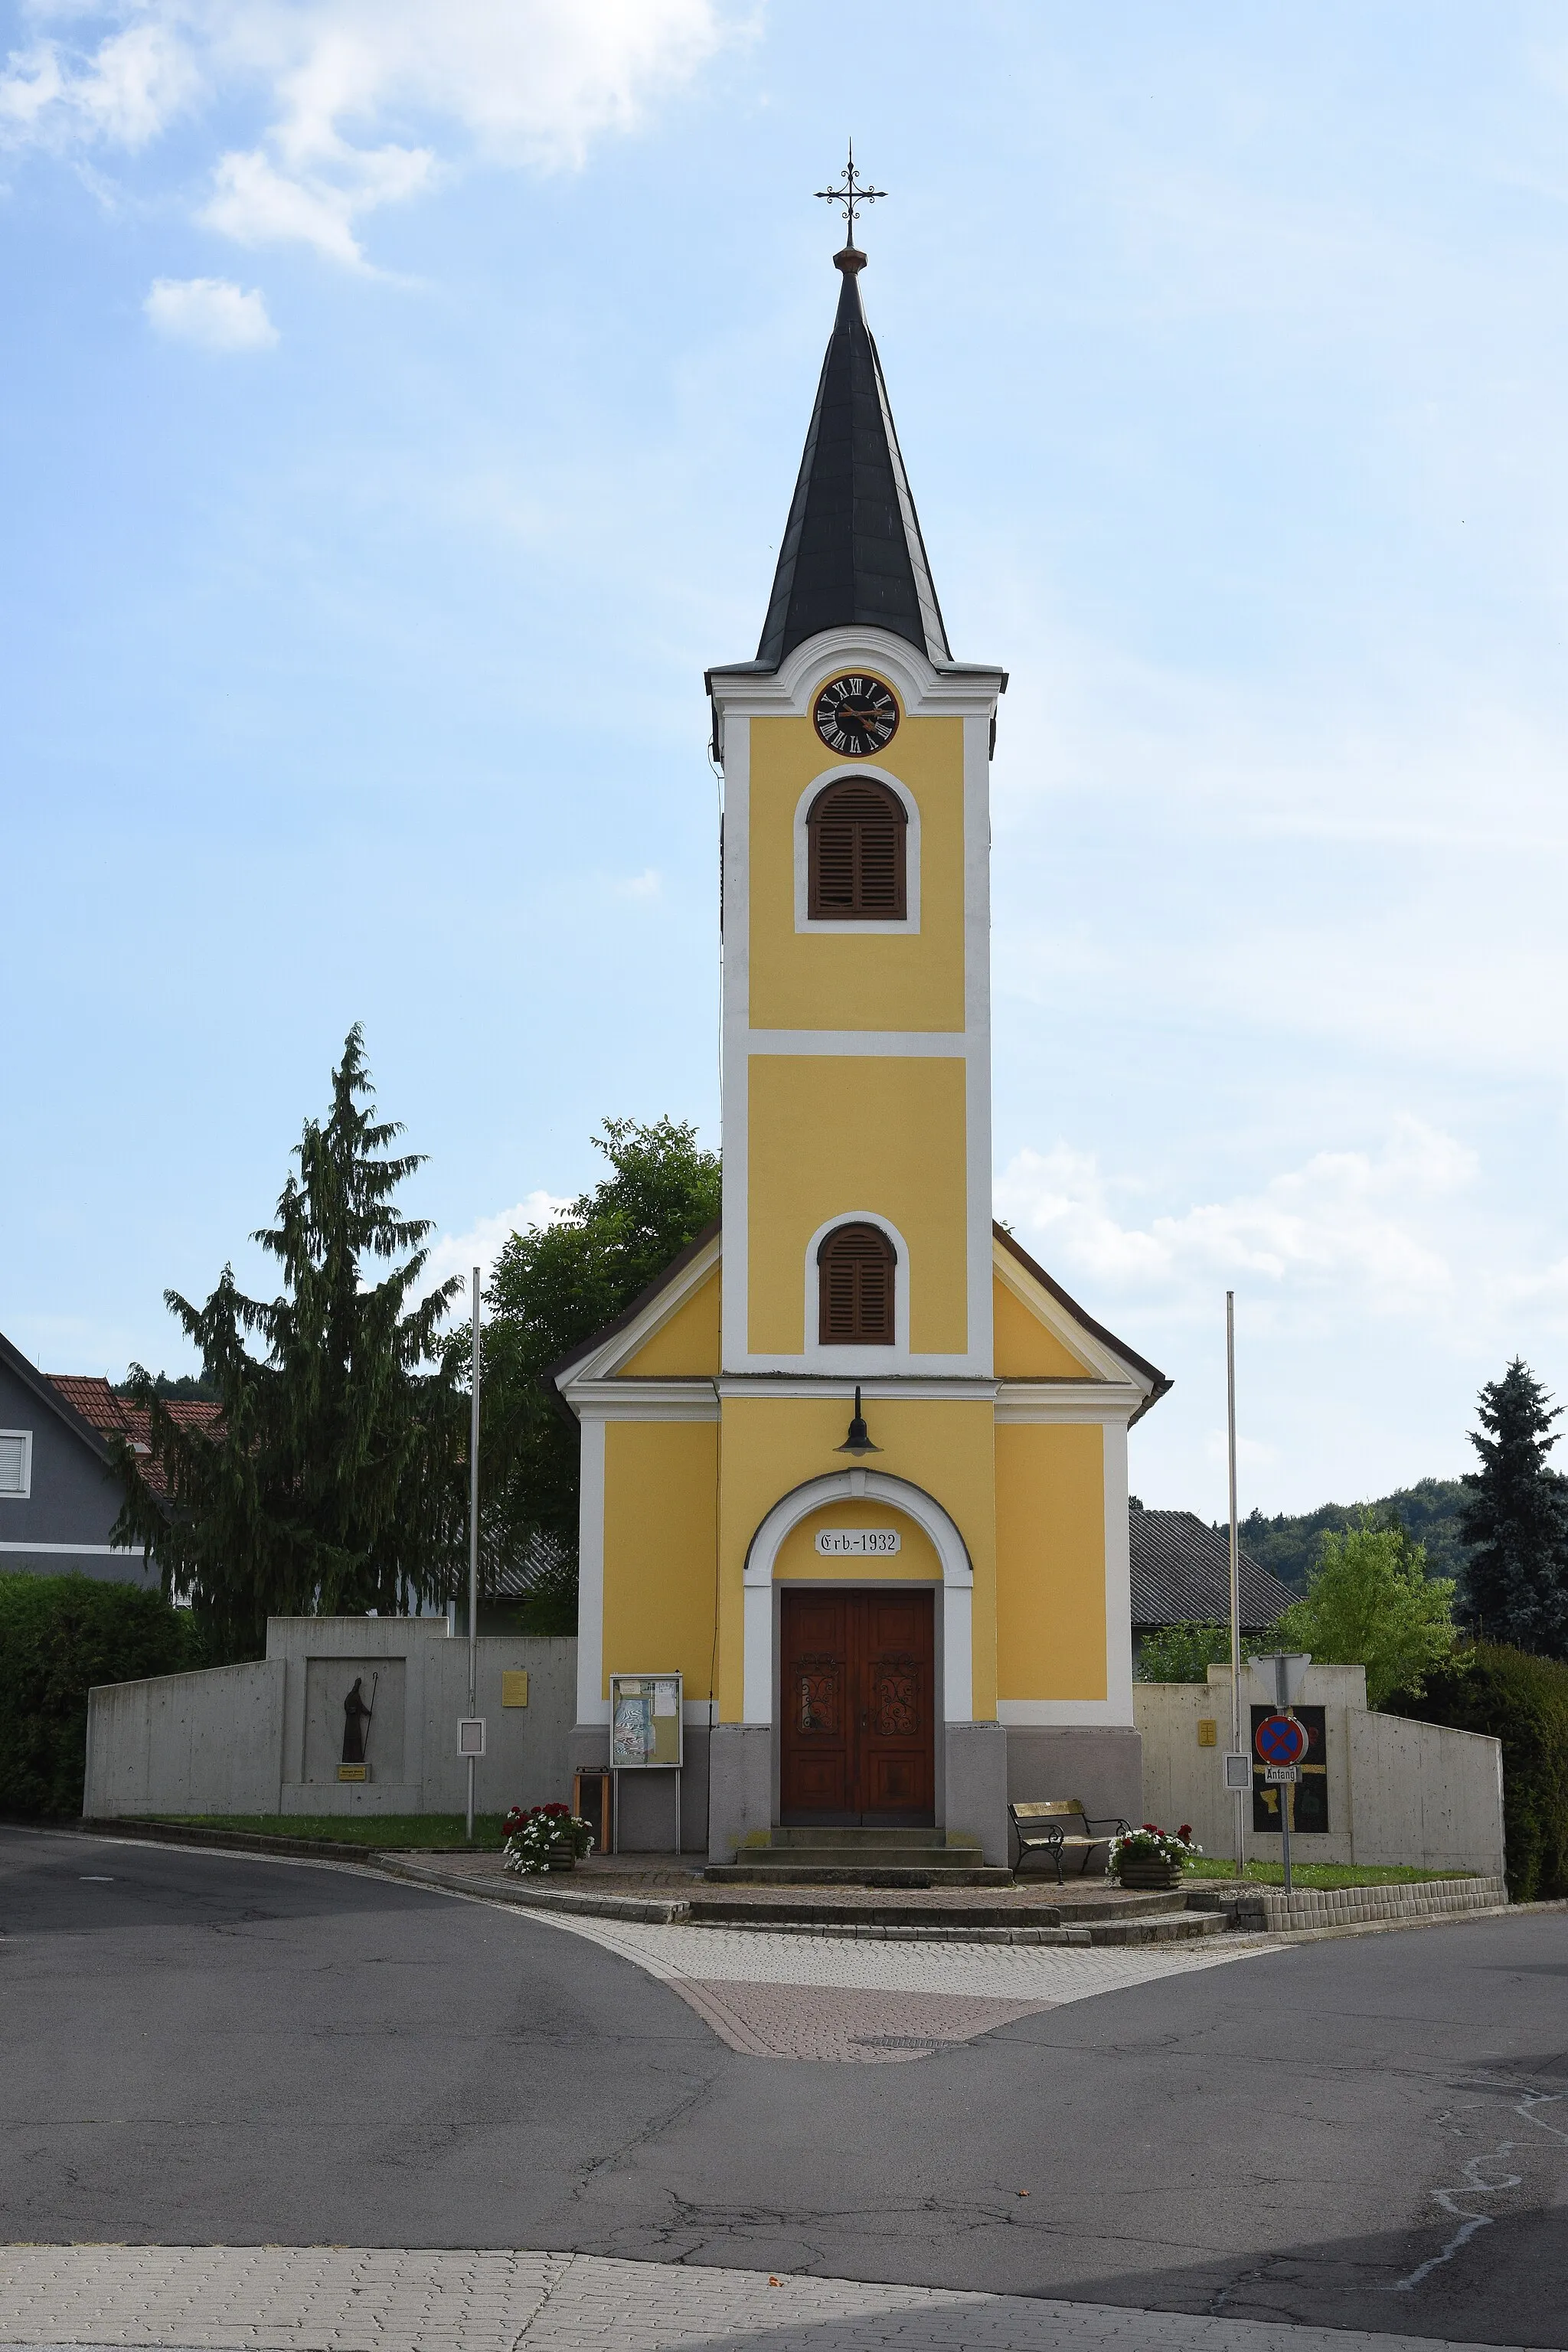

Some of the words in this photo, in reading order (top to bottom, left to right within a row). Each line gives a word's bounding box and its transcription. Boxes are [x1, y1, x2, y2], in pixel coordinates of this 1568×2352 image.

[831, 681, 849, 700] XI
[849, 678, 863, 695] XII
[865, 682, 877, 698] I
[821, 694, 839, 708] X
[873, 694, 891, 709] II
[818, 710, 835, 721] IX
[819, 720, 838, 740] VIII
[831, 730, 848, 750] VII
[850, 736, 861, 753] VI
[866, 733, 879, 750] V
[821, 1534, 895, 1550] Erb.-1932
[1267, 1769, 1295, 1782] Anfang
